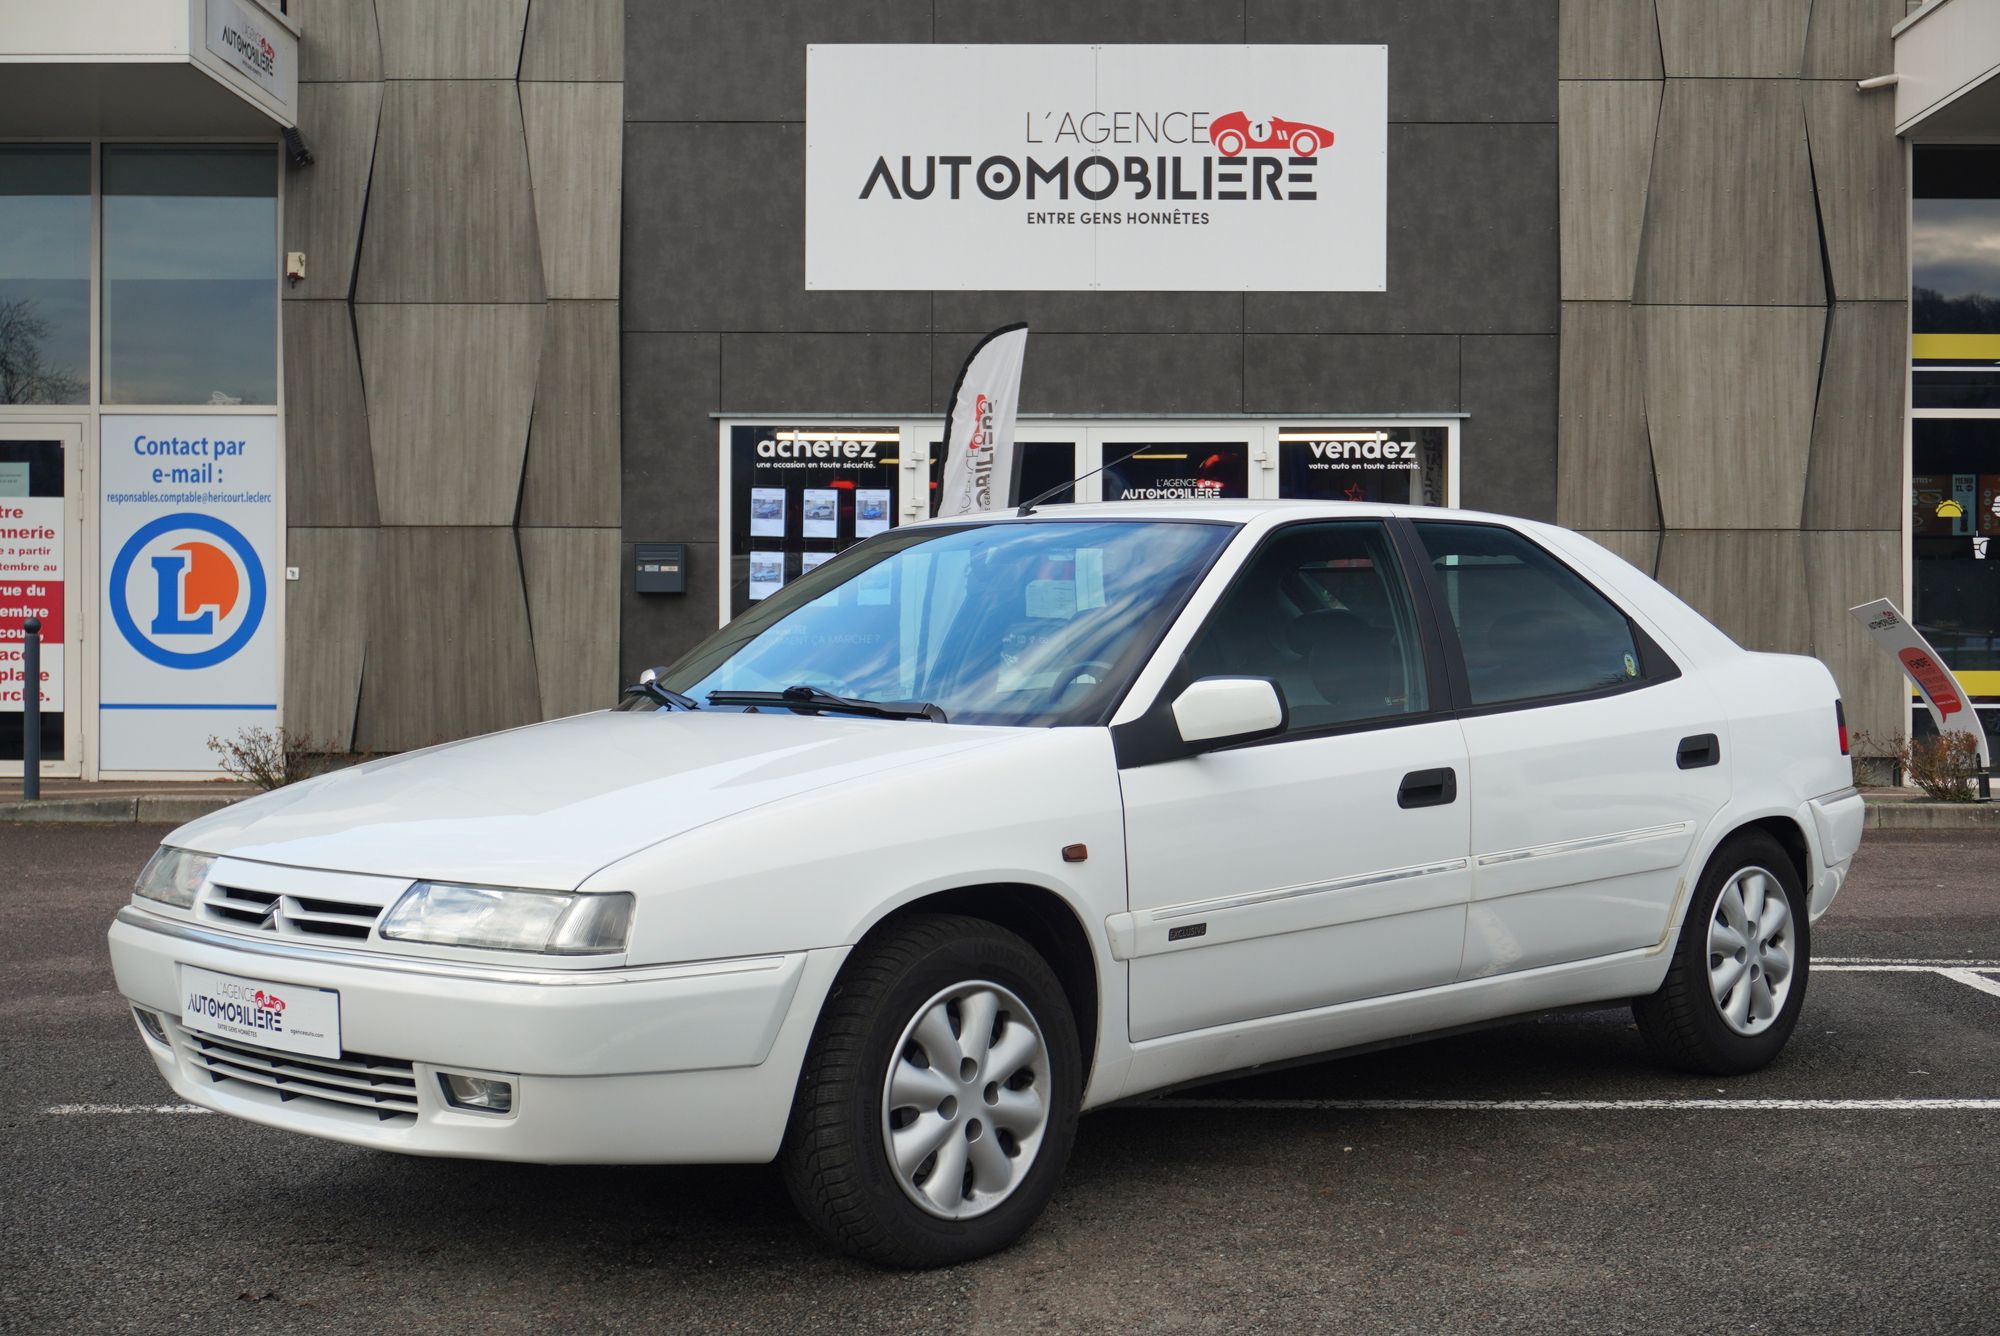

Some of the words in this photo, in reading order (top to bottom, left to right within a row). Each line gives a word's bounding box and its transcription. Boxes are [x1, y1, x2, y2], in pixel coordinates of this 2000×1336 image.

[1027, 111, 1210, 144] L'AGENCE
[1027, 212, 1075, 225] ENTRE
[1080, 212, 1122, 225] GENS
[1127, 208, 1210, 225] HONNÊTES
[134, 435, 208, 456] Contact
[214, 440, 245, 461] par
[757, 430, 876, 458] achetez
[1309, 431, 1416, 459] vendez
[773, 460, 805, 469] occasion
[820, 461, 841, 469] toute
[843, 460, 876, 469] sécurité.
[1387, 461, 1420, 470] sérénité.
[152, 463, 212, 483] e-mail
[1156, 478, 1197, 487] L'AGENCE
[107, 492, 271, 504] responsables.comptable@hericourt.leclerc
[19, 546, 52, 557] partir
[44, 564, 57, 572] au
[27, 584, 46, 596] du
[216, 980, 255, 1003] L'AGENCE
